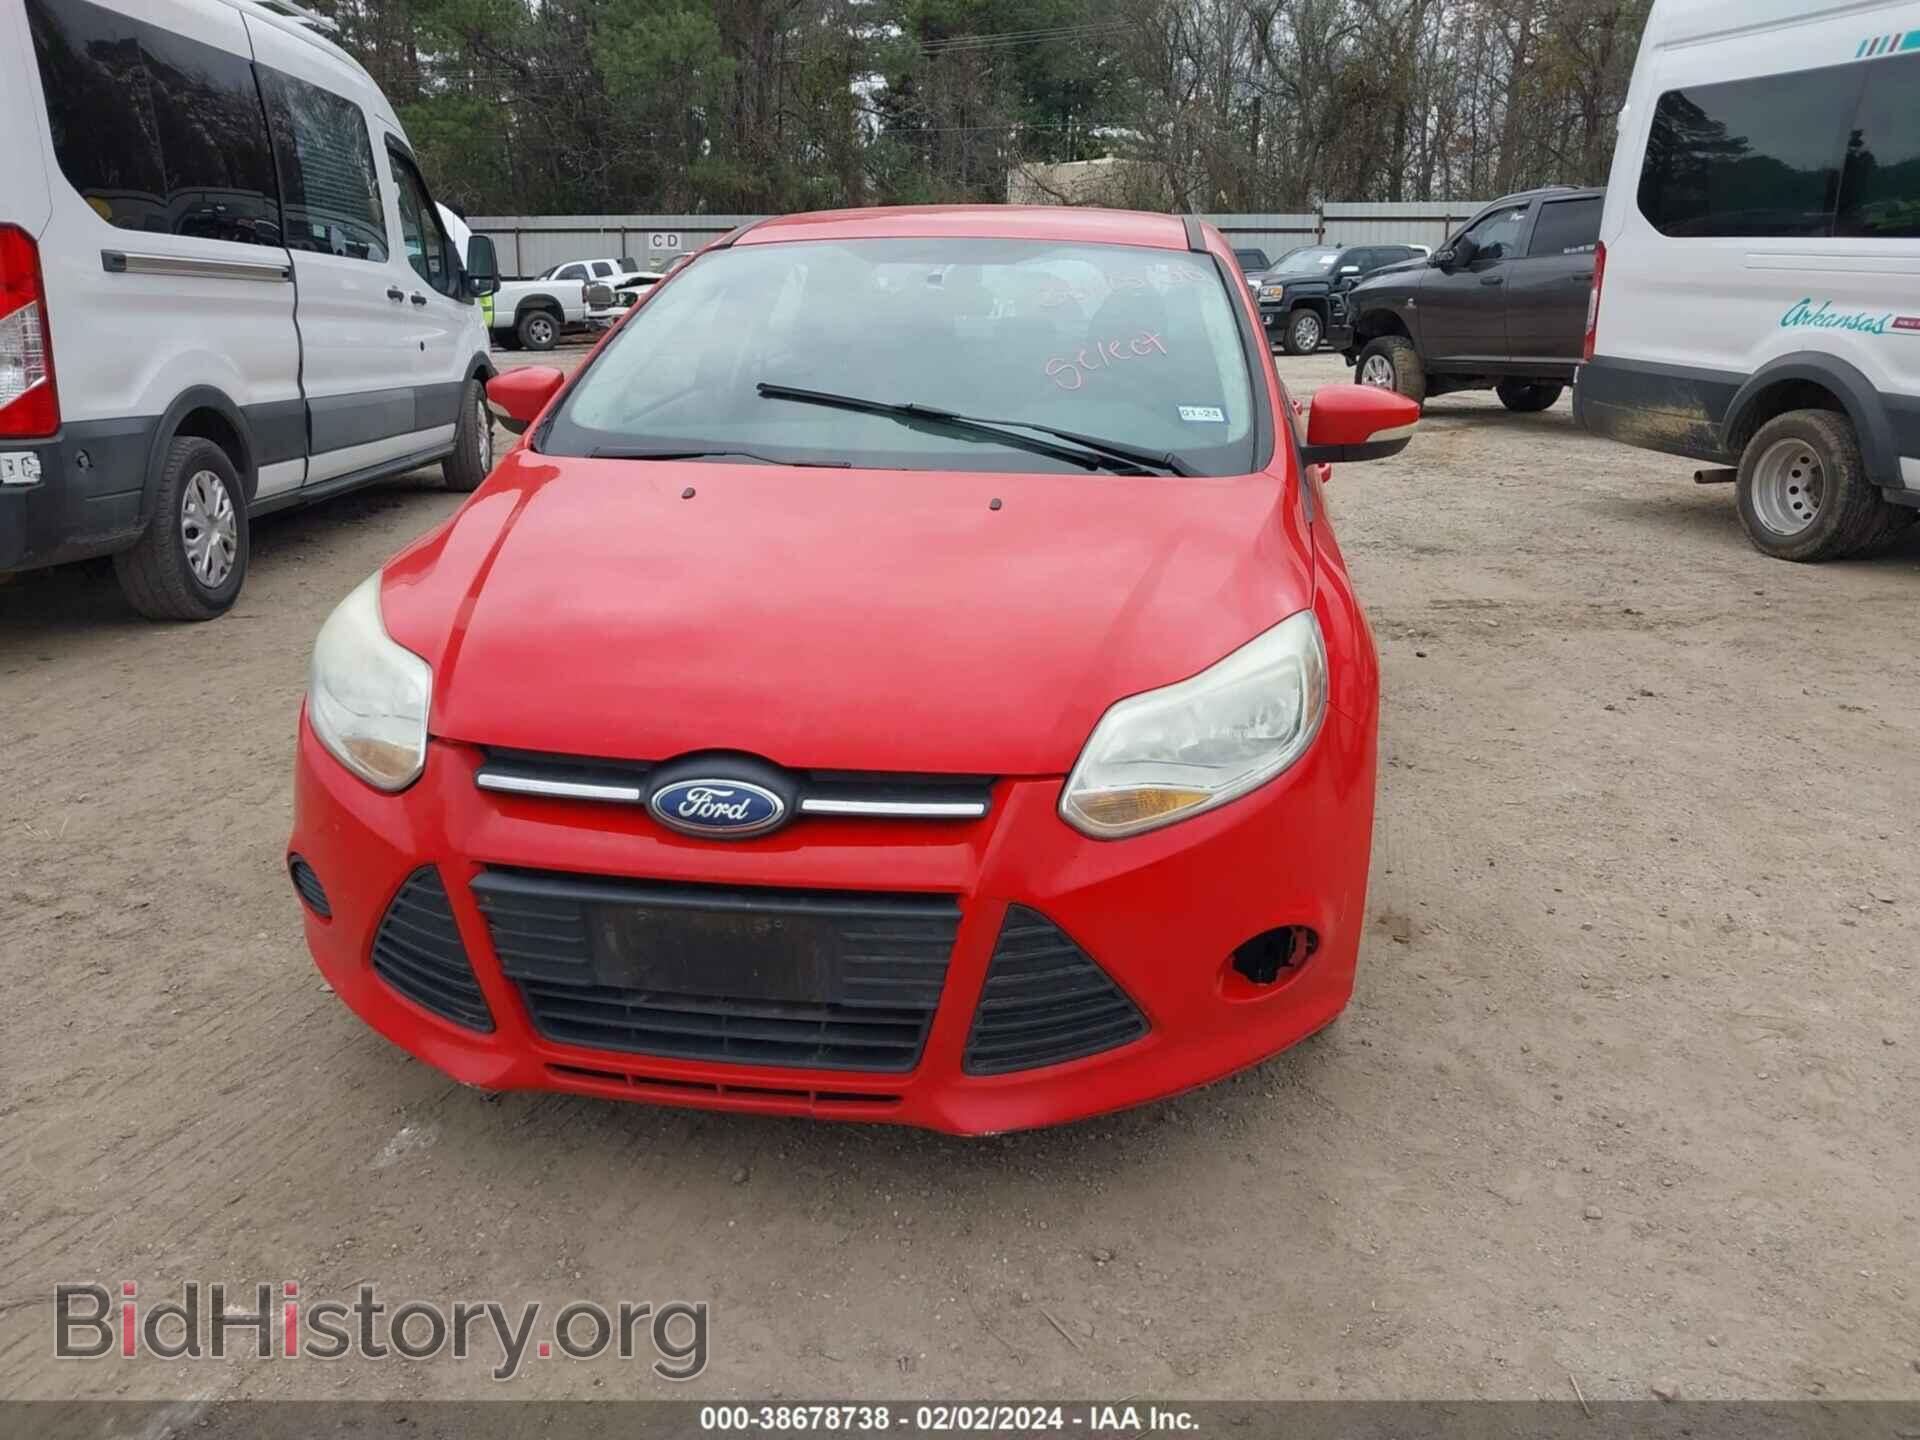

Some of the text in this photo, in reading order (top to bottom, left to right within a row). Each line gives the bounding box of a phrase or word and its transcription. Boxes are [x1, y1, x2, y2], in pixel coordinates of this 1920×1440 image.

[652, 234, 678, 247] C D
[1780, 297, 1893, 335] Arkansas
[1182, 408, 1220, 417] 01-24
[678, 787, 751, 820] Ford
